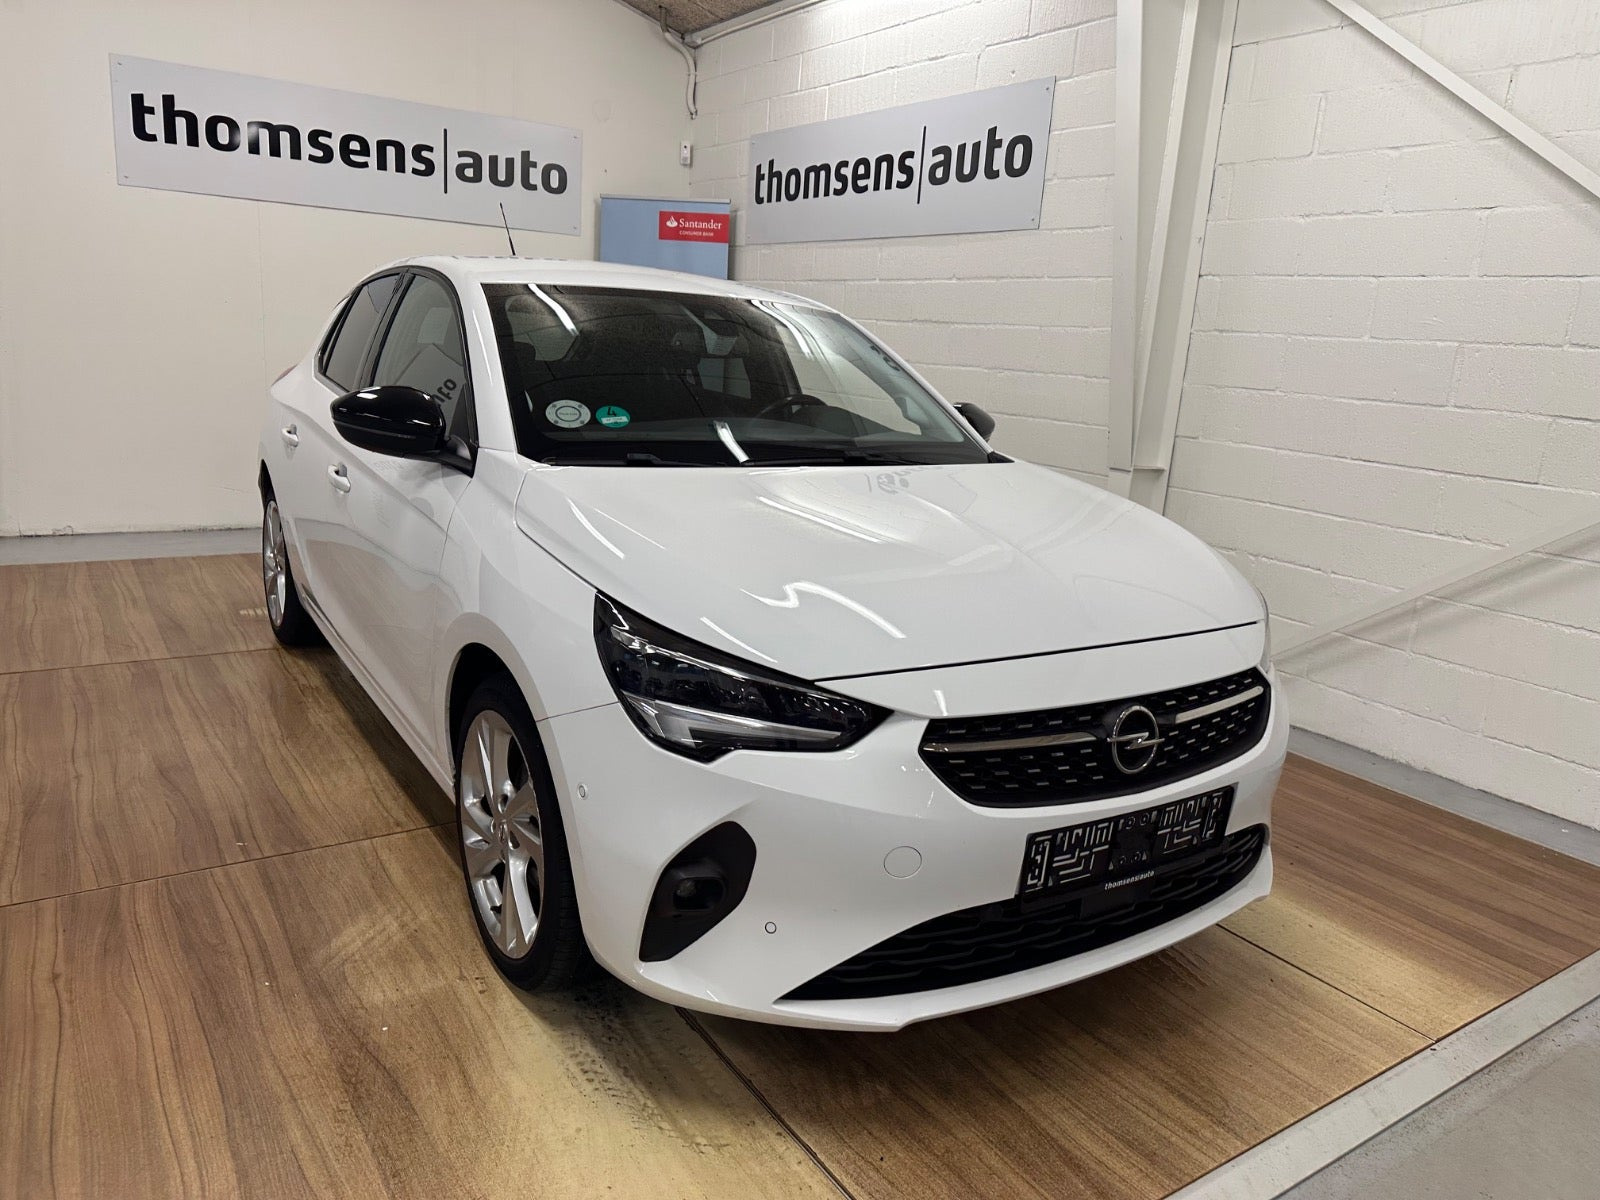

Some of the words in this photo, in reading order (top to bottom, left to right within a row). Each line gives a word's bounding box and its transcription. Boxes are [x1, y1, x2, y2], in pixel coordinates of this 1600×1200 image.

[130, 92, 436, 178] thomsens
[454, 149, 569, 196] auto
[754, 149, 916, 206] thomsens
[927, 125, 1034, 187] auto
[679, 218, 722, 229] Santander
